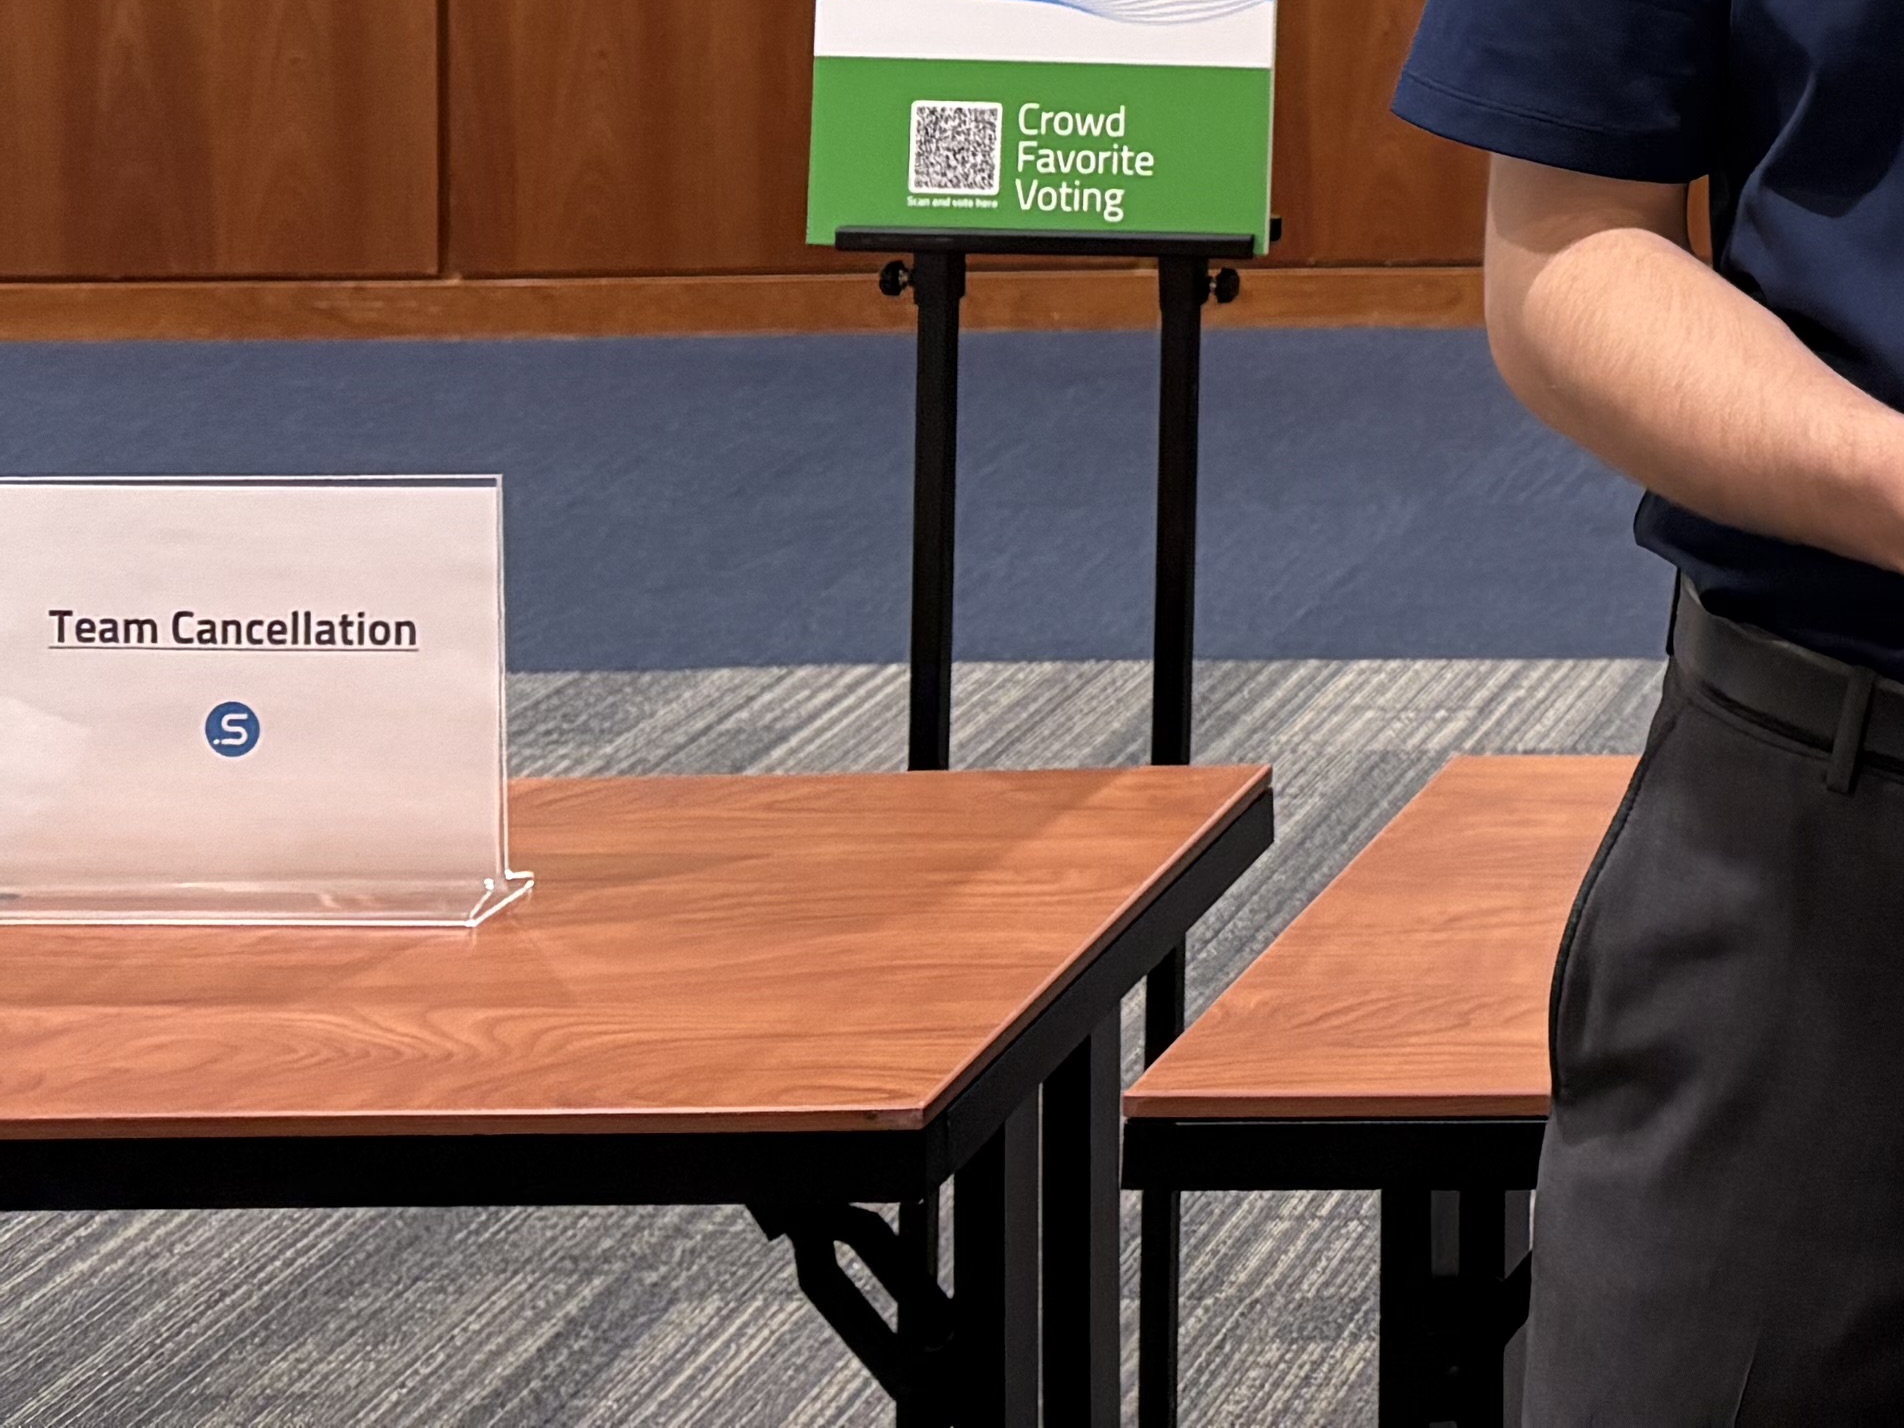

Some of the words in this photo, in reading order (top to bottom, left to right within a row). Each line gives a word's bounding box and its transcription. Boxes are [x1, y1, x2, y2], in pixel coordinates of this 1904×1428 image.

[1019, 103, 1125, 137] Crowd
[1018, 141, 1154, 175] Favorite
[1016, 179, 1124, 222] Voting
[49, 610, 158, 643] Team
[172, 611, 417, 645] Cancellation
